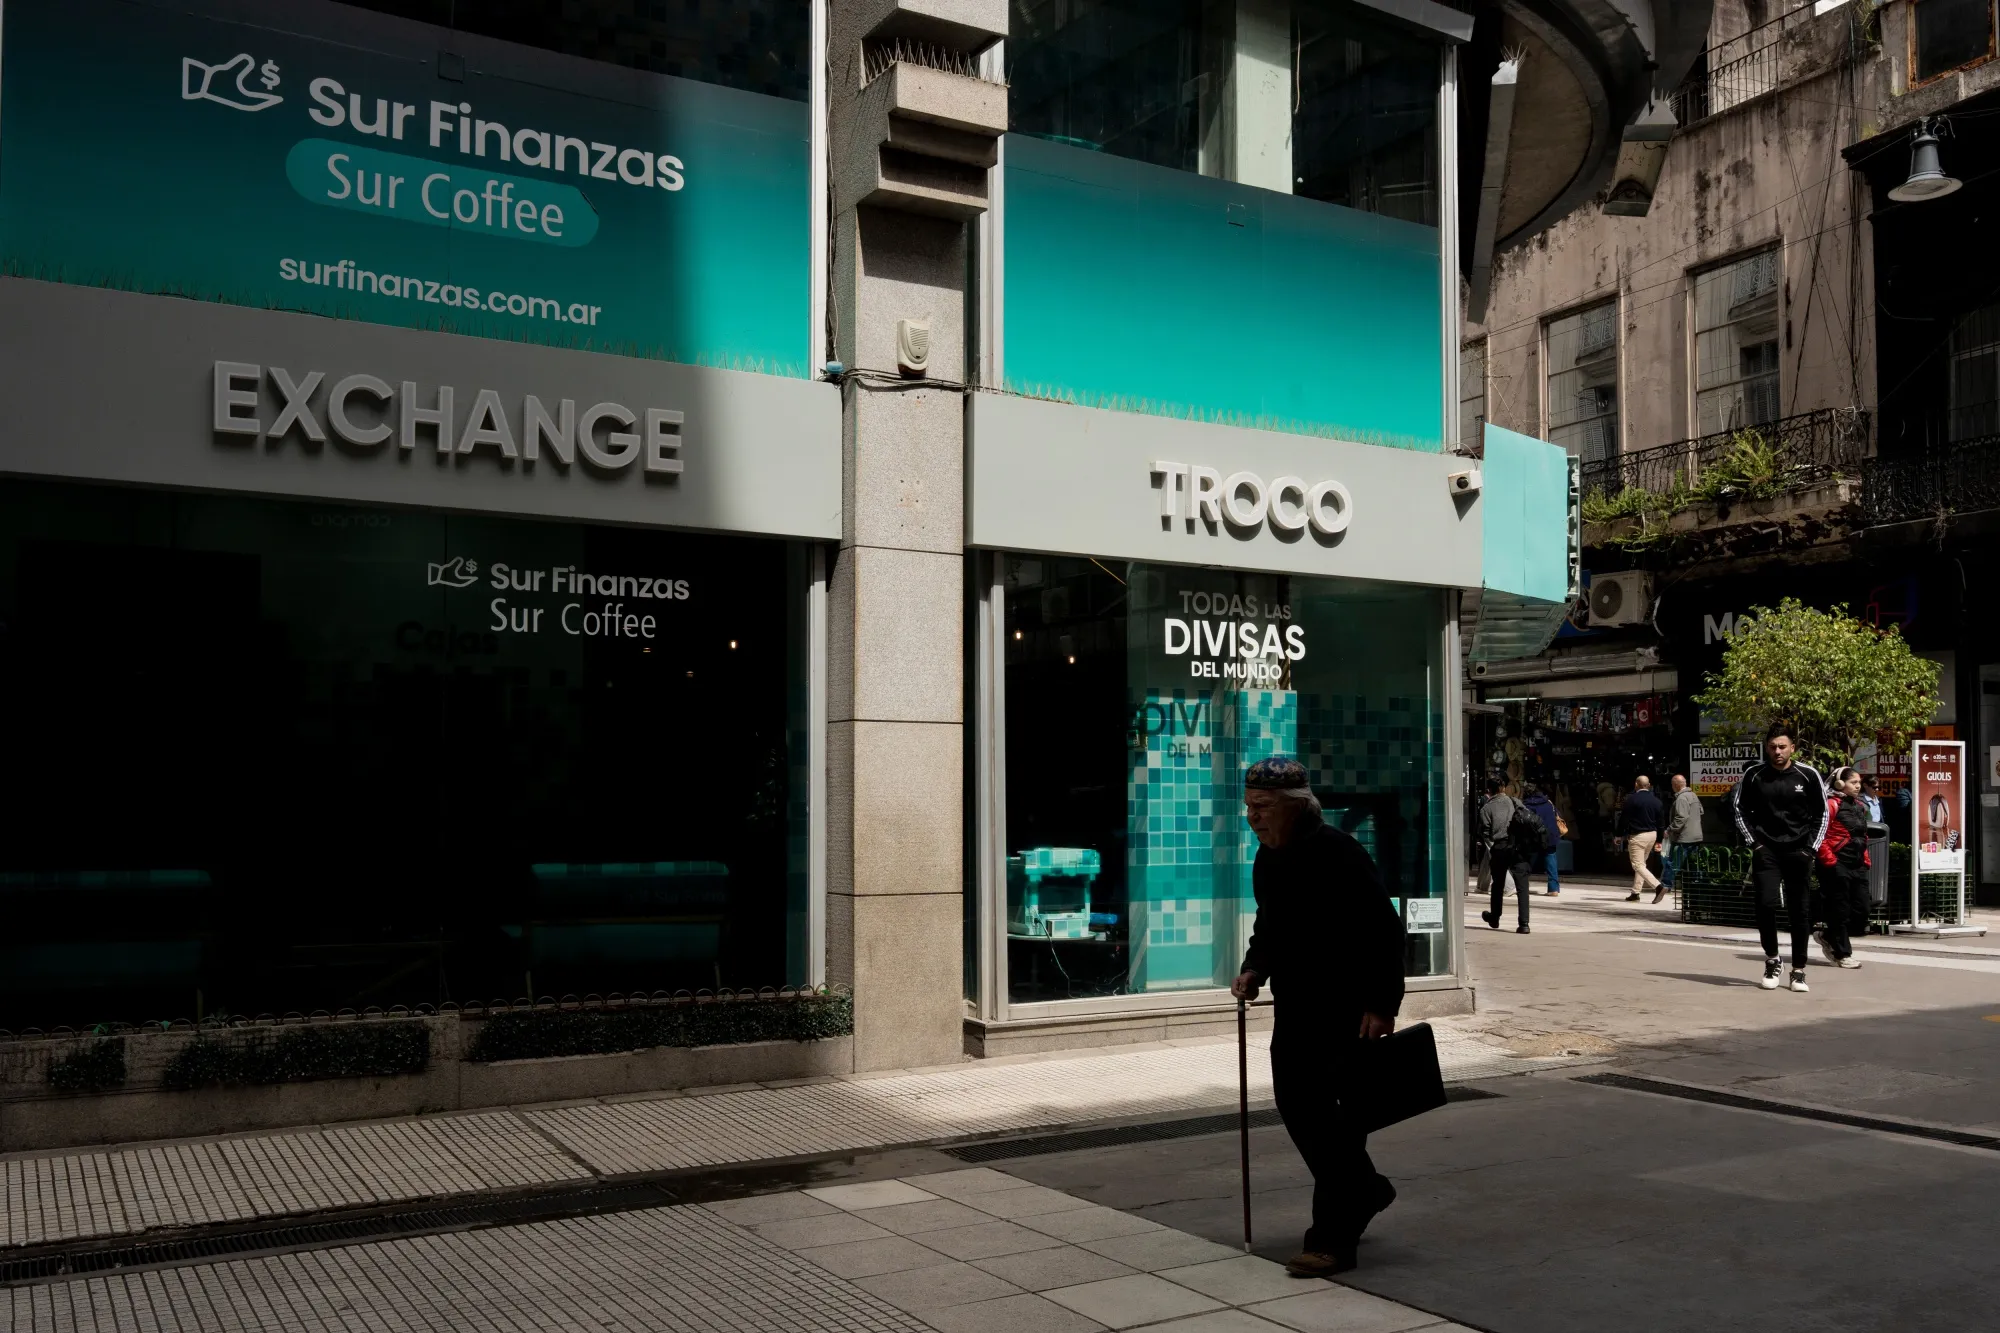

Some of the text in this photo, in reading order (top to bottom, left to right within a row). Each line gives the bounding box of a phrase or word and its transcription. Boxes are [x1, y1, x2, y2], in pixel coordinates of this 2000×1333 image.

[308, 76, 685, 191] Sur Finanzas
[327, 153, 564, 237] Sur Coffee
[279, 257, 602, 326] surfinanzas.com.ar
[213, 360, 685, 474] EXCHANGE
[1150, 460, 1353, 533] TROCO
[490, 563, 690, 600] Sur Finanzas
[490, 598, 656, 638] Sur Coffee
[1179, 590, 1292, 620] TODAS LAS
[1165, 618, 1306, 661] DIVISAS
[1191, 661, 1282, 680] DEL MUNDO
[1880, 765, 1898, 775] SUP.
